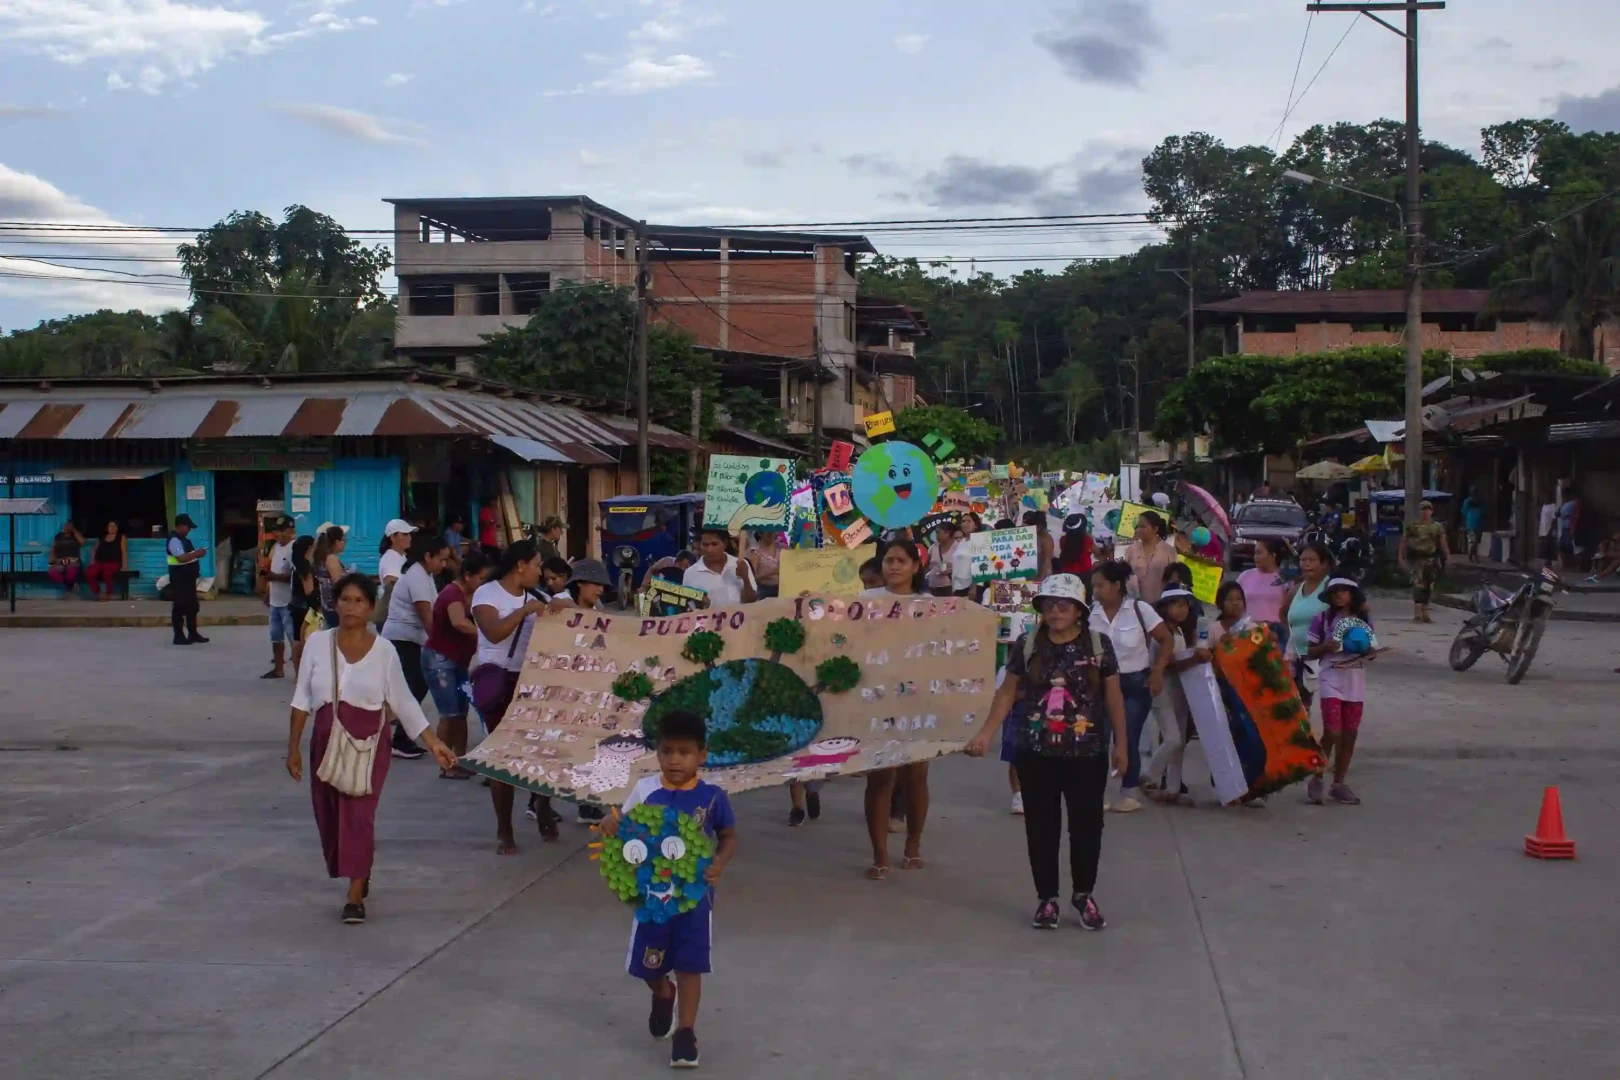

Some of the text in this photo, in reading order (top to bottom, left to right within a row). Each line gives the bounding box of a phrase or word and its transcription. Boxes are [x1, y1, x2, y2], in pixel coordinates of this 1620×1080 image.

[991, 535, 1014, 543] PARA
[990, 542, 1035, 552] VIDA AL
[573, 633, 607, 651] LA
